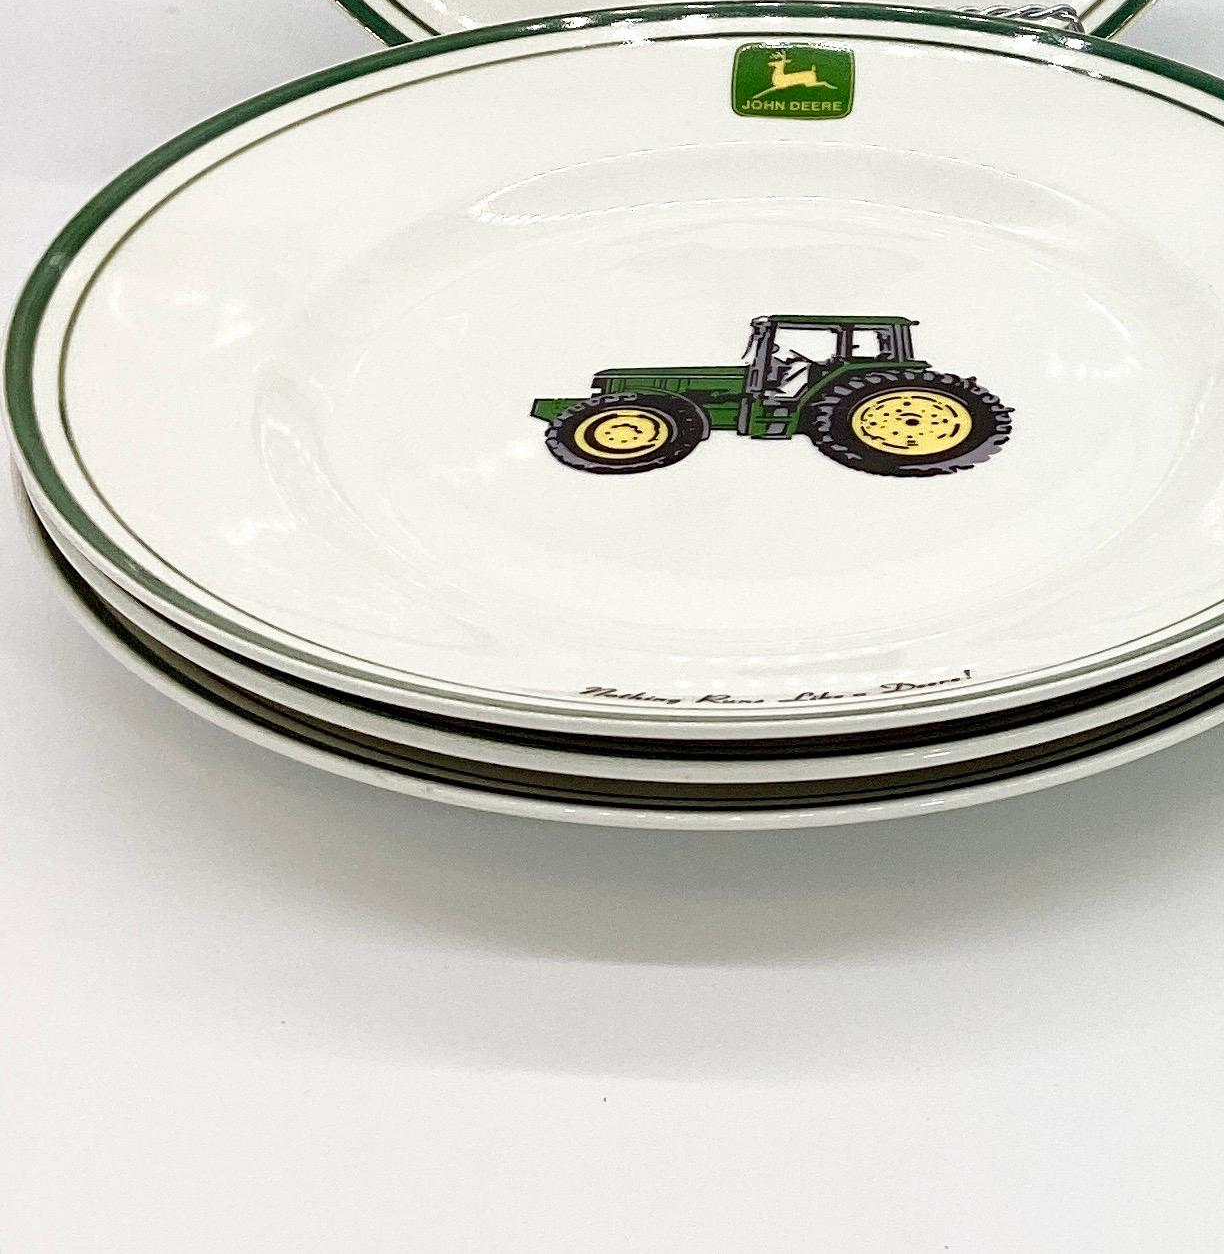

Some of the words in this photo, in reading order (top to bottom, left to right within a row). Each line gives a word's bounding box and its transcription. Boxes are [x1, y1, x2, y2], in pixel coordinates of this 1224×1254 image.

[741, 99, 785, 111] JOHN
[789, 100, 843, 112] DEERE
[578, 686, 681, 705] Nothing
